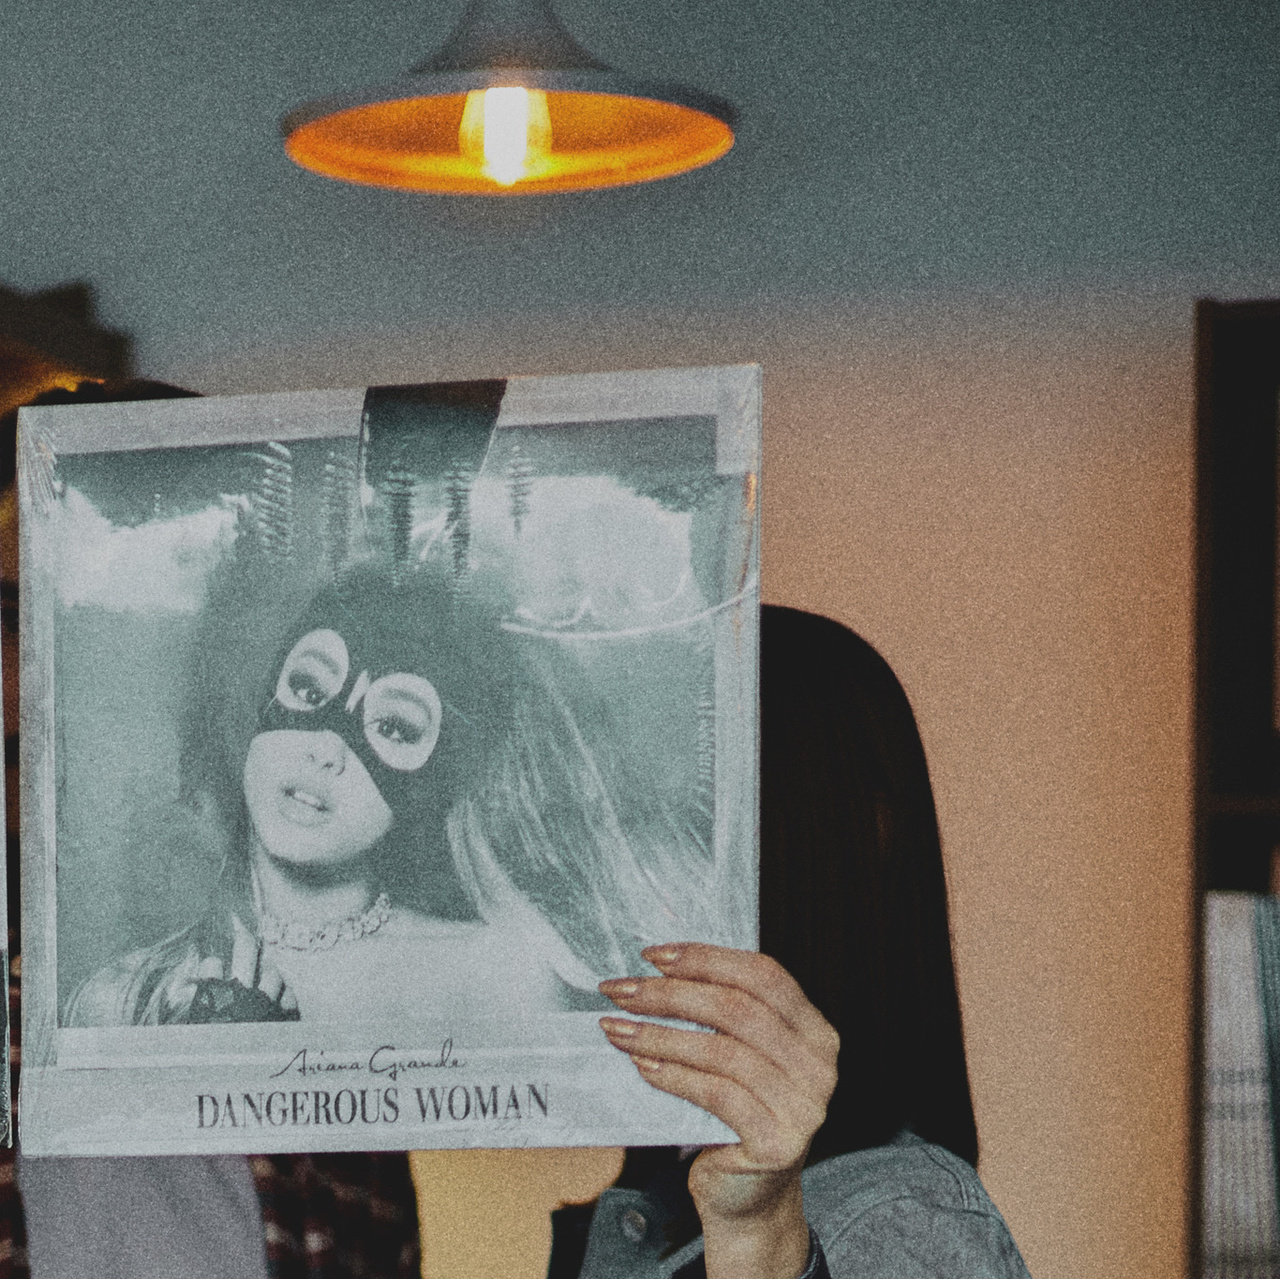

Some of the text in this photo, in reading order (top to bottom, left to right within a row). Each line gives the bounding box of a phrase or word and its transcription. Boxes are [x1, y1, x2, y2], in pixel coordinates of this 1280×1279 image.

[270, 1038, 467, 1081] Ariana Grande
[196, 1081, 551, 1130] DANGEROUS WOMAN
